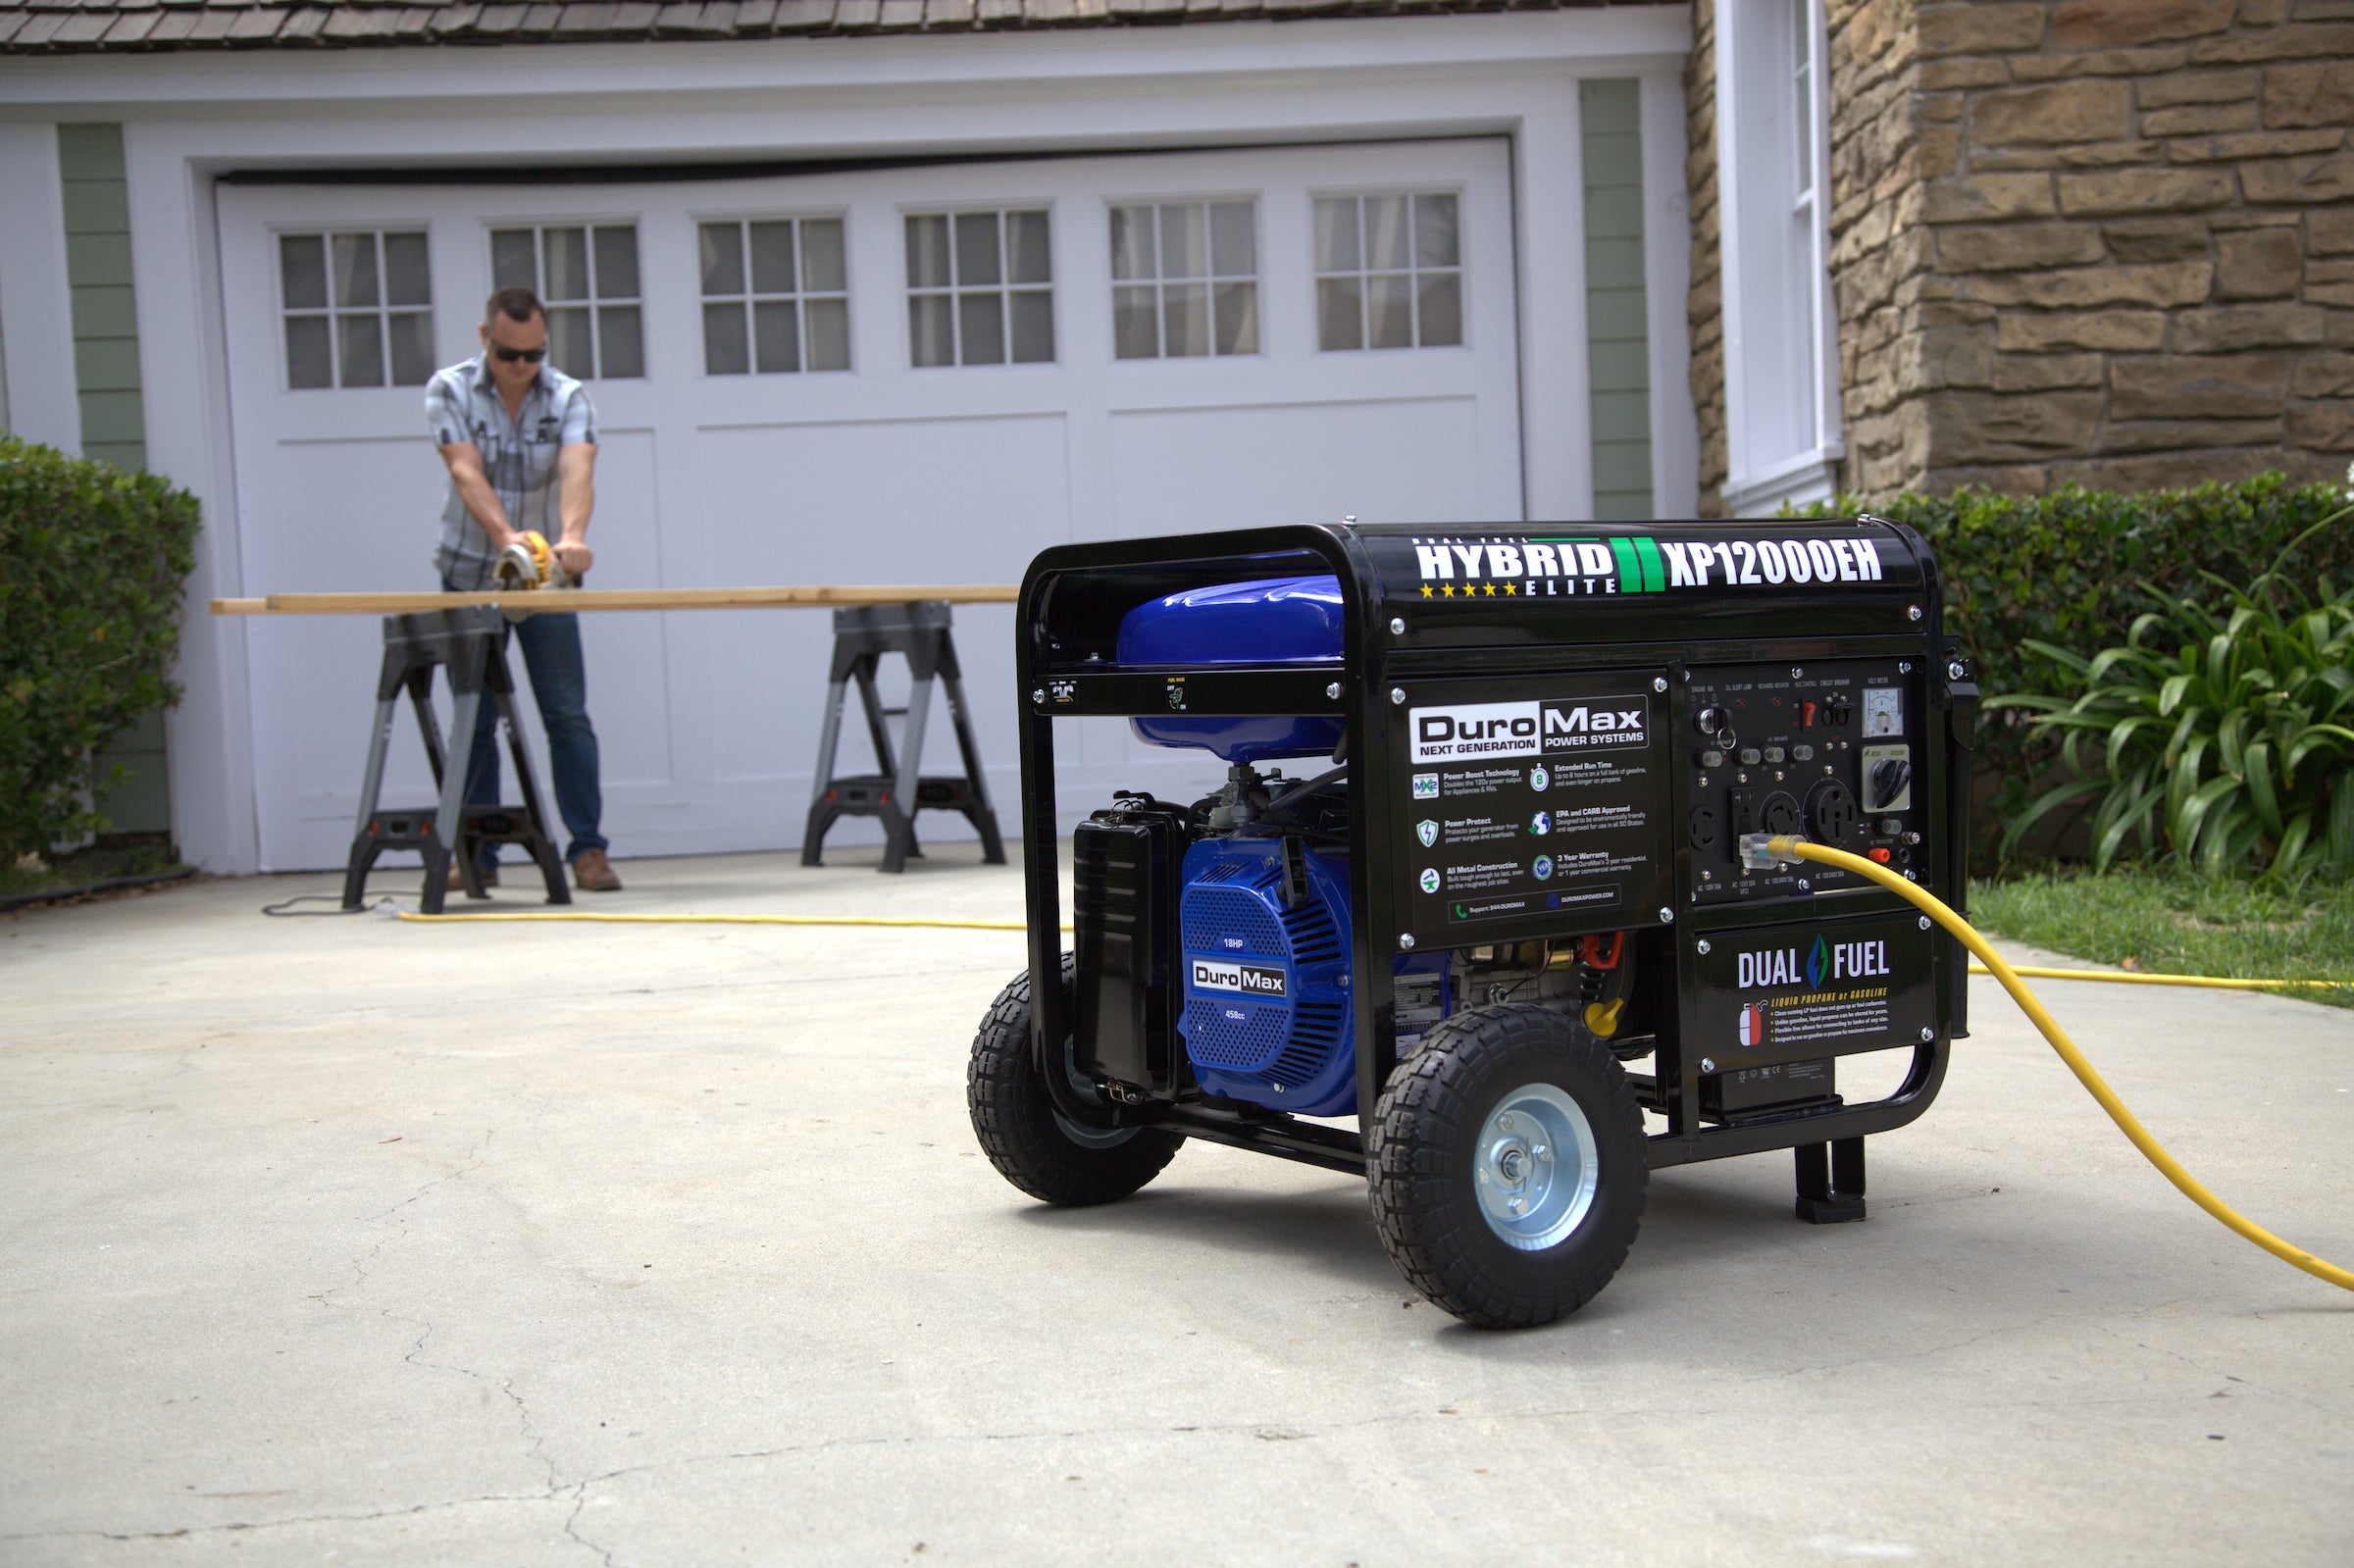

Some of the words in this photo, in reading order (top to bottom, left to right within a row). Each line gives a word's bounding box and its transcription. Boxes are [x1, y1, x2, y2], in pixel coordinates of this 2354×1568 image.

[1415, 544, 1614, 579] HYBRID
[1661, 539, 1882, 587] XP12000EH
[1526, 578, 1616, 596] ELITE
[1419, 707, 1642, 743] DuroMax
[1420, 745, 1453, 756] NEXT
[1458, 739, 1535, 753] GENERATION
[1545, 736, 1587, 747] POWER
[1591, 732, 1644, 744] SYSTEMS
[1485, 769, 1520, 777] Technology
[1536, 774, 1543, 784] 8
[1582, 807, 1601, 815] CARB
[1602, 805, 1630, 815] Approved
[1567, 824, 1589, 833] approved
[1579, 851, 1609, 861] Warranty
[1457, 865, 1476, 873] Metal
[1477, 862, 1518, 872] Construction
[1464, 881, 1487, 889] roughest
[1224, 938, 1243, 948] 18HP
[1738, 948, 1802, 988] DUAL
[1834, 940, 1889, 979] FUEL
[1196, 966, 1283, 991] DuroMax
[1771, 997, 1799, 1007] LIQUID
[1801, 993, 1837, 1004] PROPANE
[1850, 987, 1887, 999] GASOLINE
[1225, 1010, 1245, 1020] 458cc
